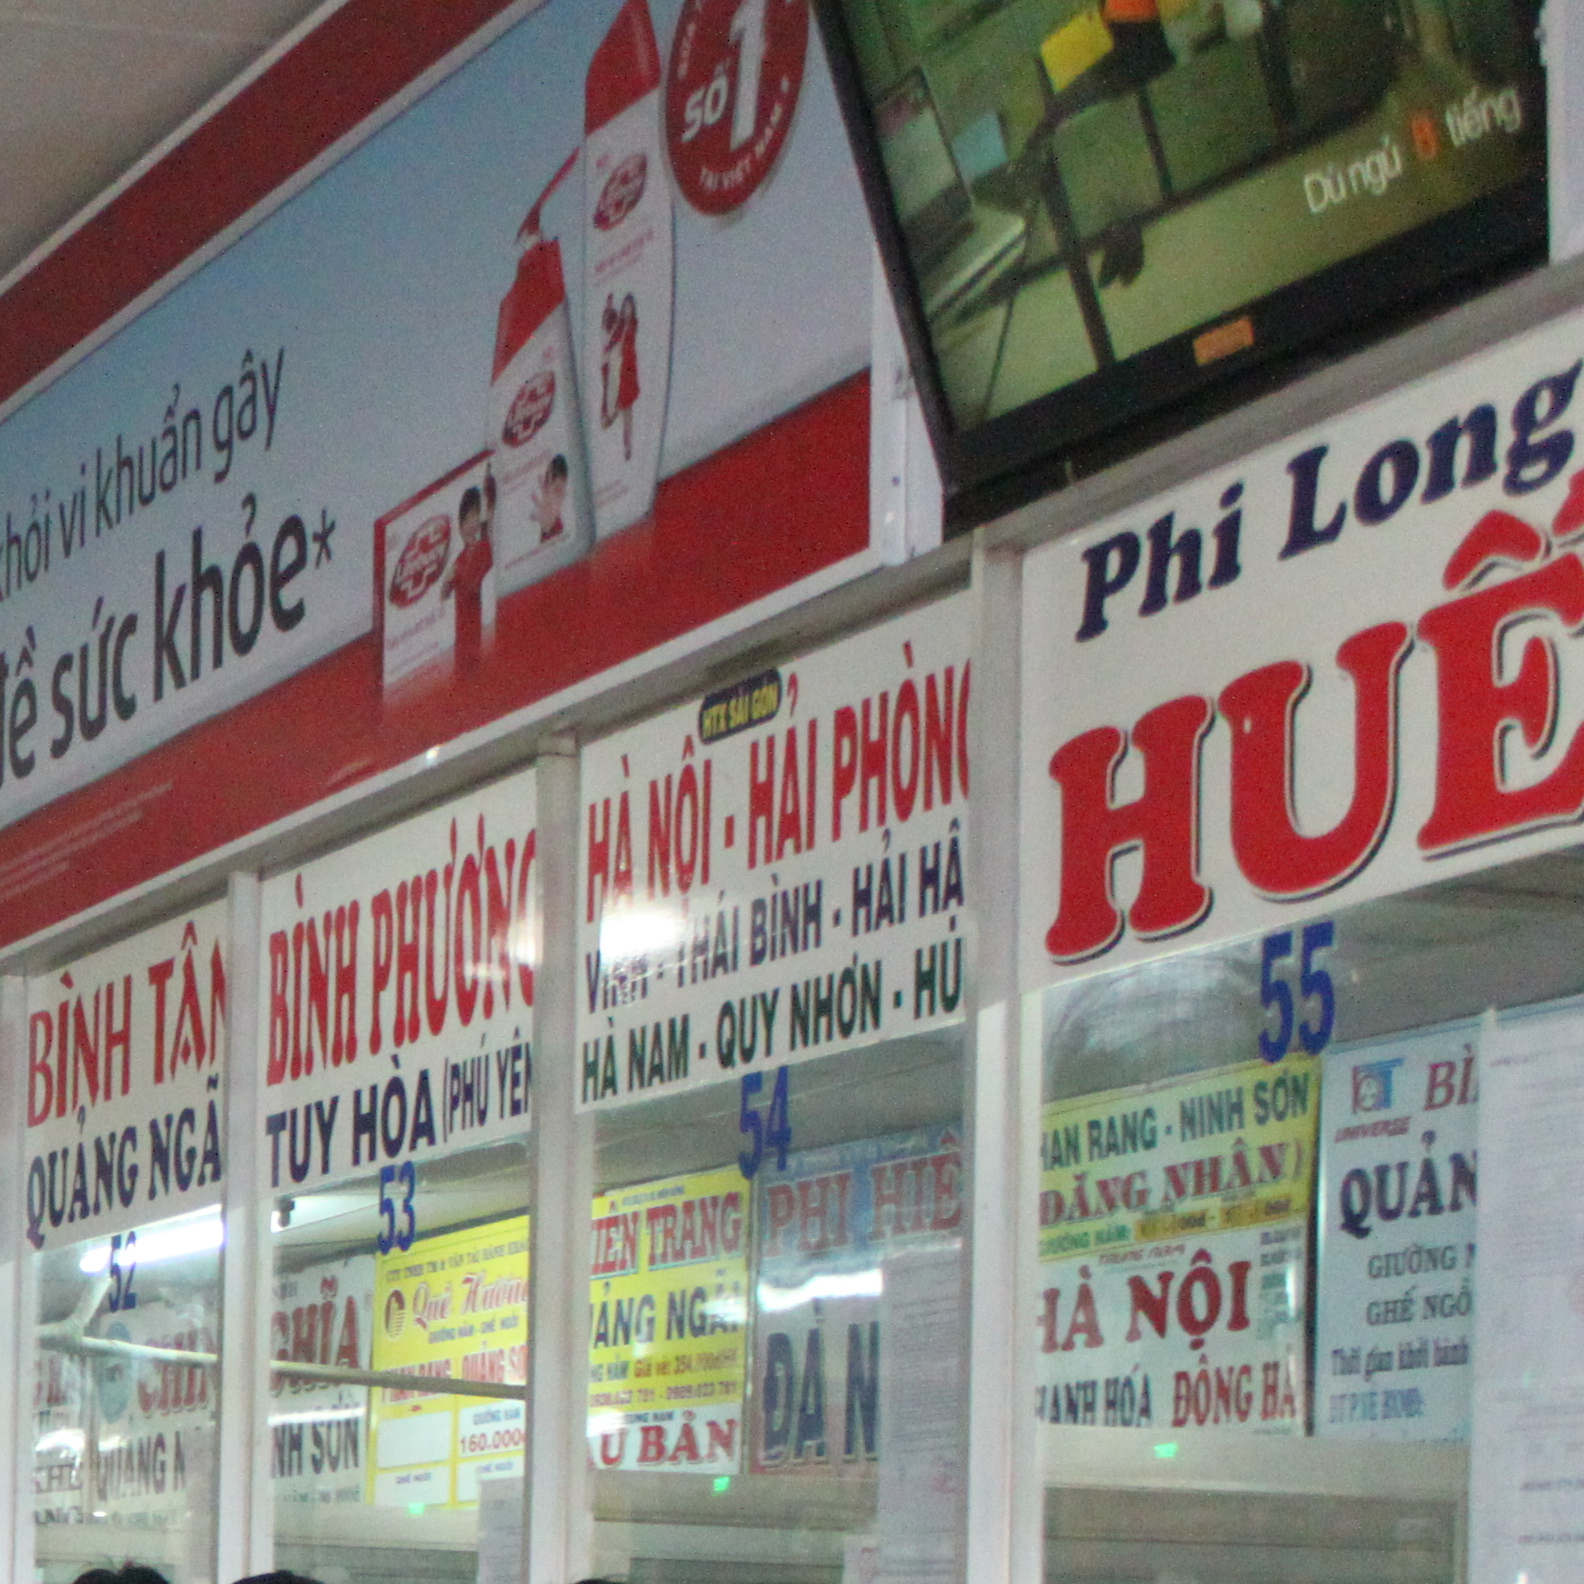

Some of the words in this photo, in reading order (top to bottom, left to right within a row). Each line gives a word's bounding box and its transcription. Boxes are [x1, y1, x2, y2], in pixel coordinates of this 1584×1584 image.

[58, 463, 88, 559] vi
[95, 384, 203, 534] khuẩn
[212, 346, 285, 483] gây
[1075, 479, 1245, 643] Phi
[1277, 357, 1584, 561] Long
[50, 601, 138, 756] sức
[1044, 469, 1584, 965] HUẾ
[586, 754, 633, 924] HÀ
[648, 734, 712, 916] NỘI
[747, 673, 818, 870] HẢI
[677, 890, 739, 988] THÁI
[749, 873, 823, 967] BÌNH
[851, 830, 906, 936] HẢI
[27, 970, 133, 1128] BÌNH
[582, 1017, 617, 1104] HÀ
[628, 1014, 689, 1092] NAM
[716, 988, 780, 1069] QUY
[790, 950, 881, 1050] NHƠN
[1258, 920, 1336, 1064] 55
[266, 1095, 340, 1188] TUY
[352, 1054, 436, 1166] HÒA
[739, 1065, 791, 1180] 54
[1087, 1107, 1158, 1162] RANG
[1180, 1085, 1247, 1143] NINH
[1253, 1069, 1310, 1126] SƠN
[1423, 1042, 1478, 1112] BÌ
[27, 1104, 138, 1249] QUẢNG
[377, 1160, 417, 1255] 53
[647, 1191, 743, 1267] TRANG
[765, 1170, 851, 1257] PHI
[109, 1231, 136, 1313] 52
[1126, 1248, 1252, 1351] NỘI
[637, 1410, 739, 1467] BẢN
[760, 1299, 828, 1466] ĐÀ
[1104, 1363, 1152, 1427] HÓA
